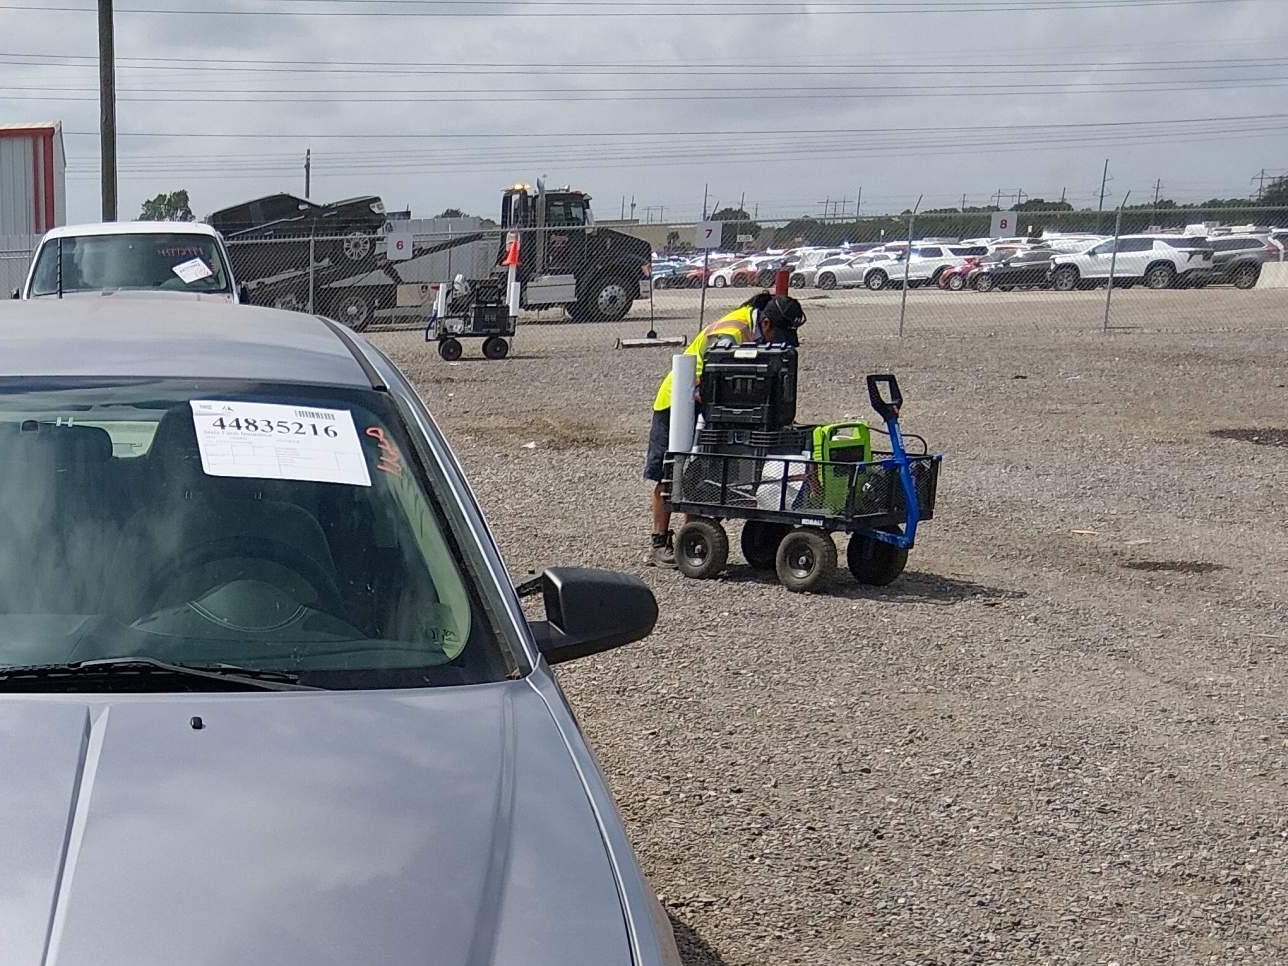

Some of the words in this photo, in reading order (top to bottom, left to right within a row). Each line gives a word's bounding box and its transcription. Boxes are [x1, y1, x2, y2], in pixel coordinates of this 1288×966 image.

[1000, 219, 1008, 229] 8
[705, 228, 713, 238] 7
[396, 240, 404, 250] 6
[212, 416, 339, 439] 44835216
